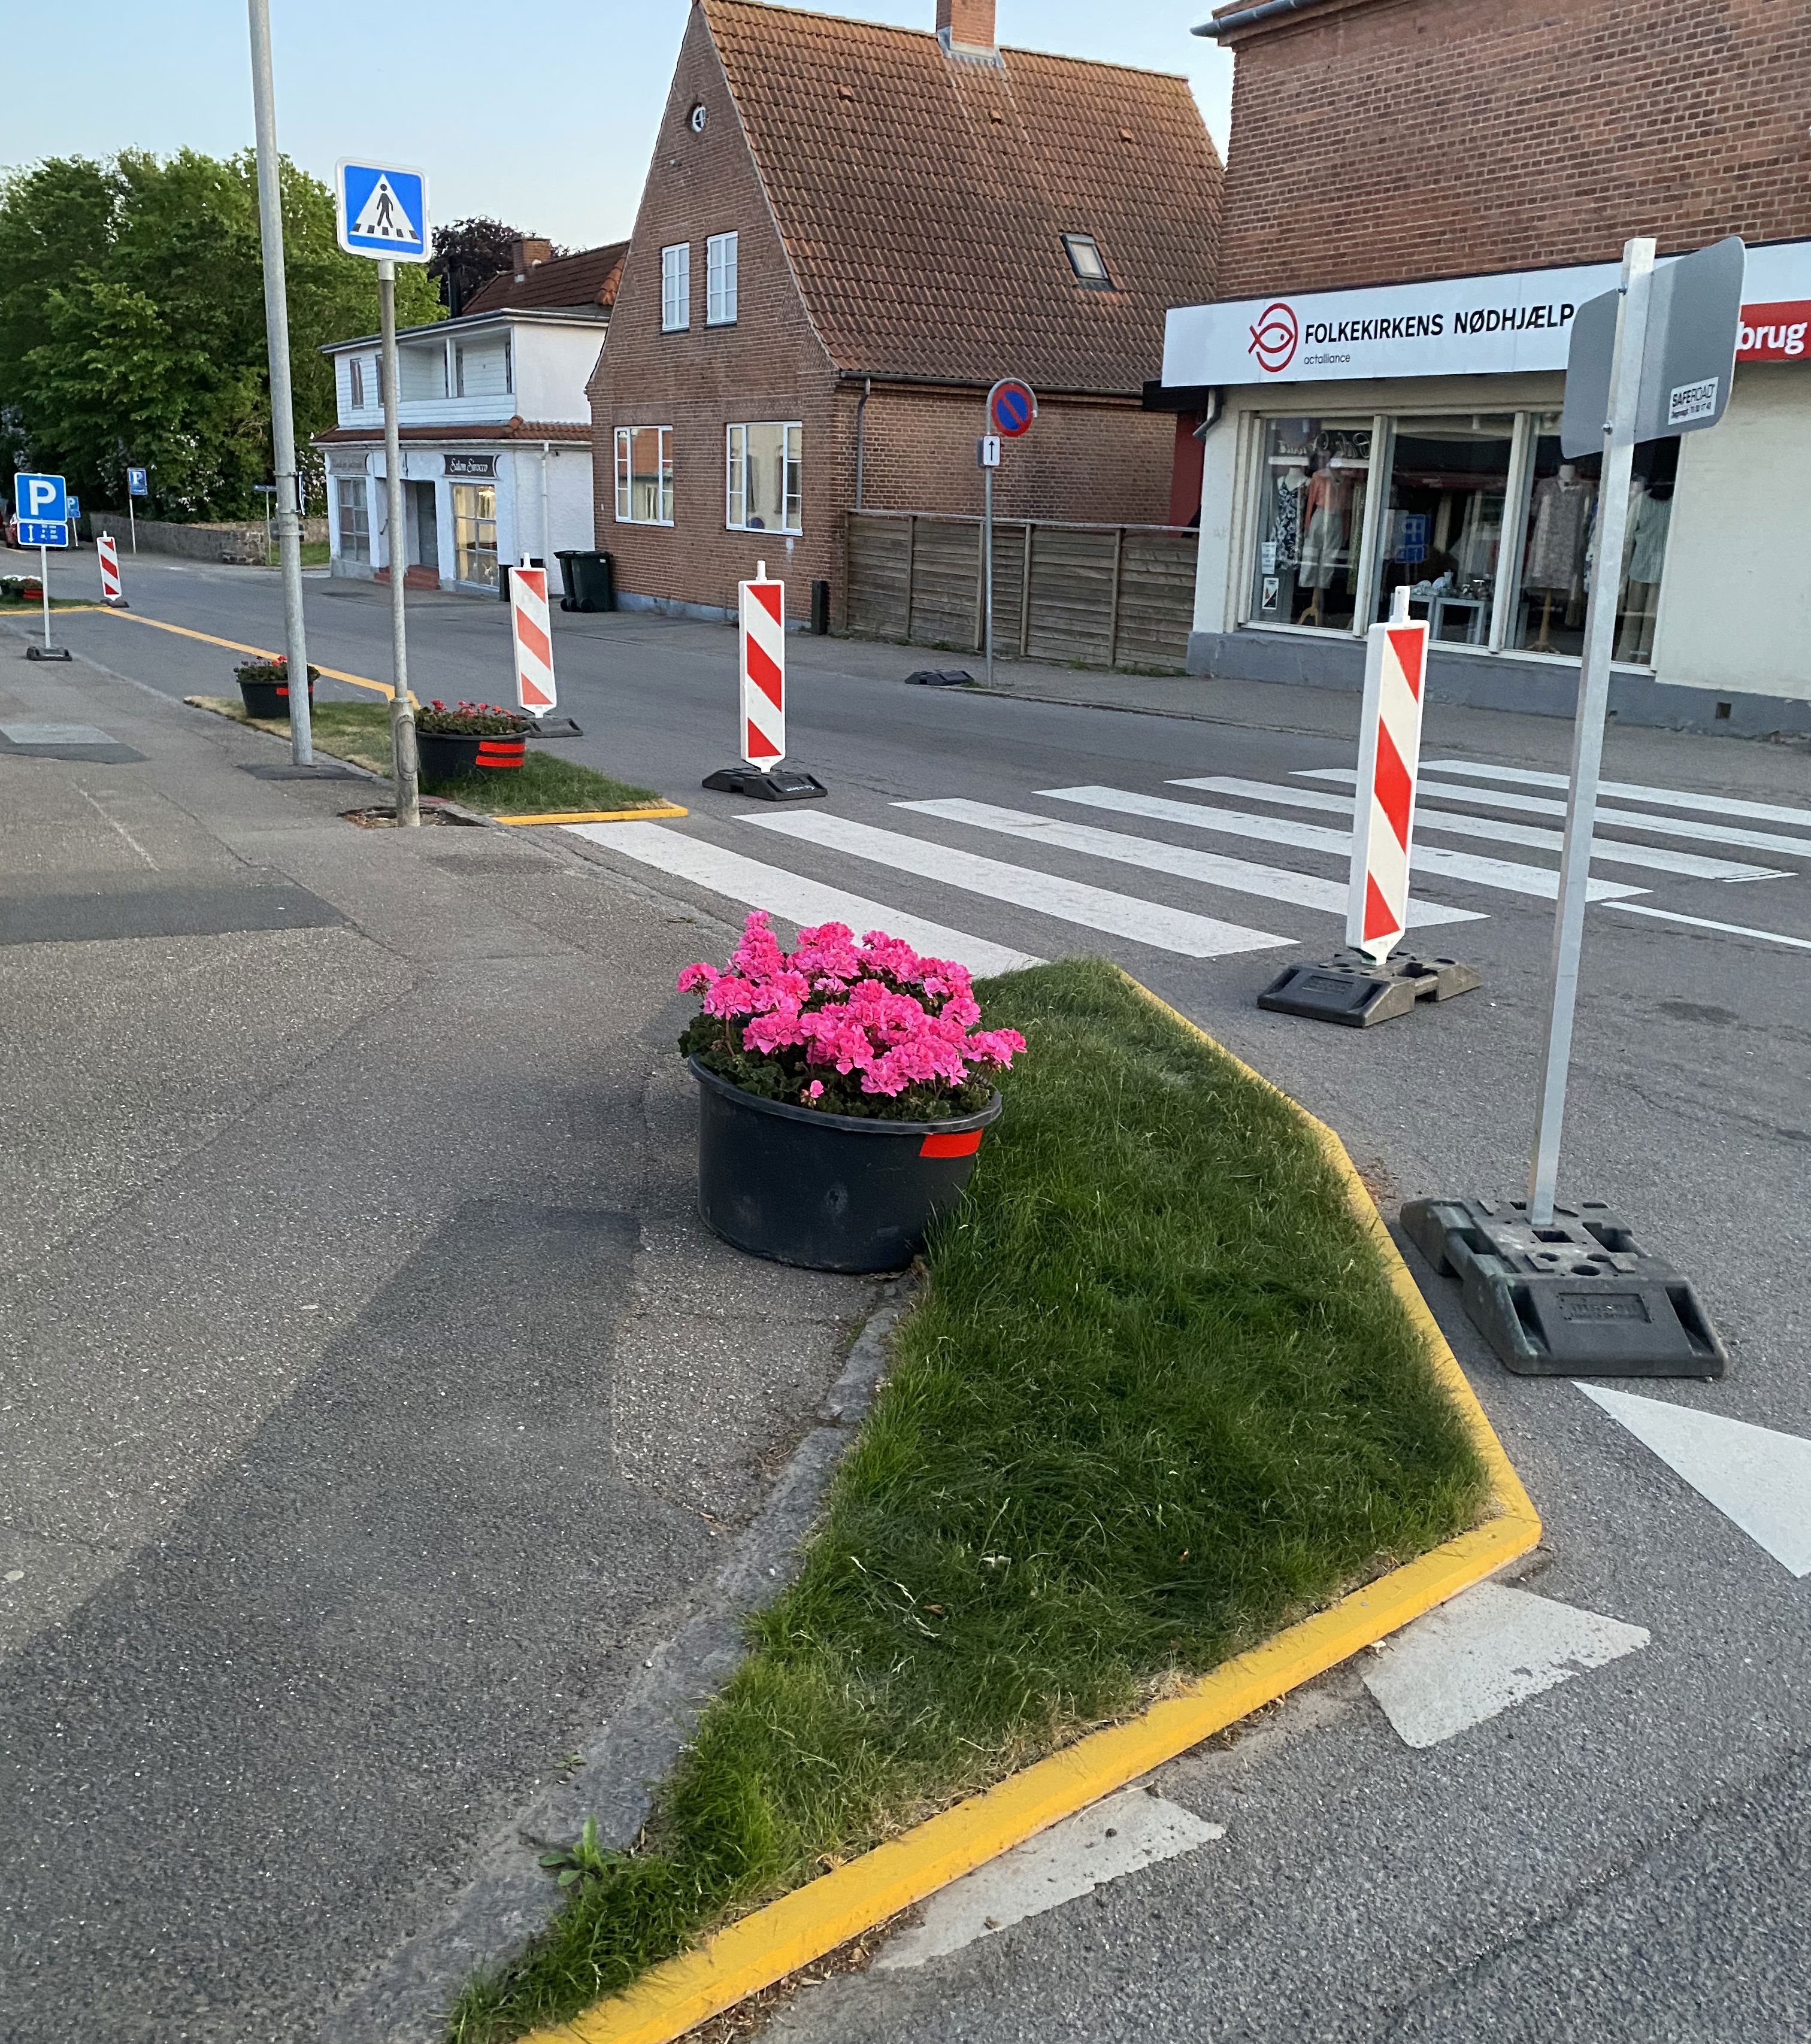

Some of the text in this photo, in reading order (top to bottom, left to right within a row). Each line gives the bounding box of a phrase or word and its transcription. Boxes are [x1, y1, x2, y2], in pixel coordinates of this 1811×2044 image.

[1305, 304, 1574, 344] FOLKEKIRKENS NØDHJÆLP
[1735, 321, 1808, 355] brug
[132, 471, 143, 484] P
[28, 480, 56, 515] P
[67, 497, 75, 510] P
